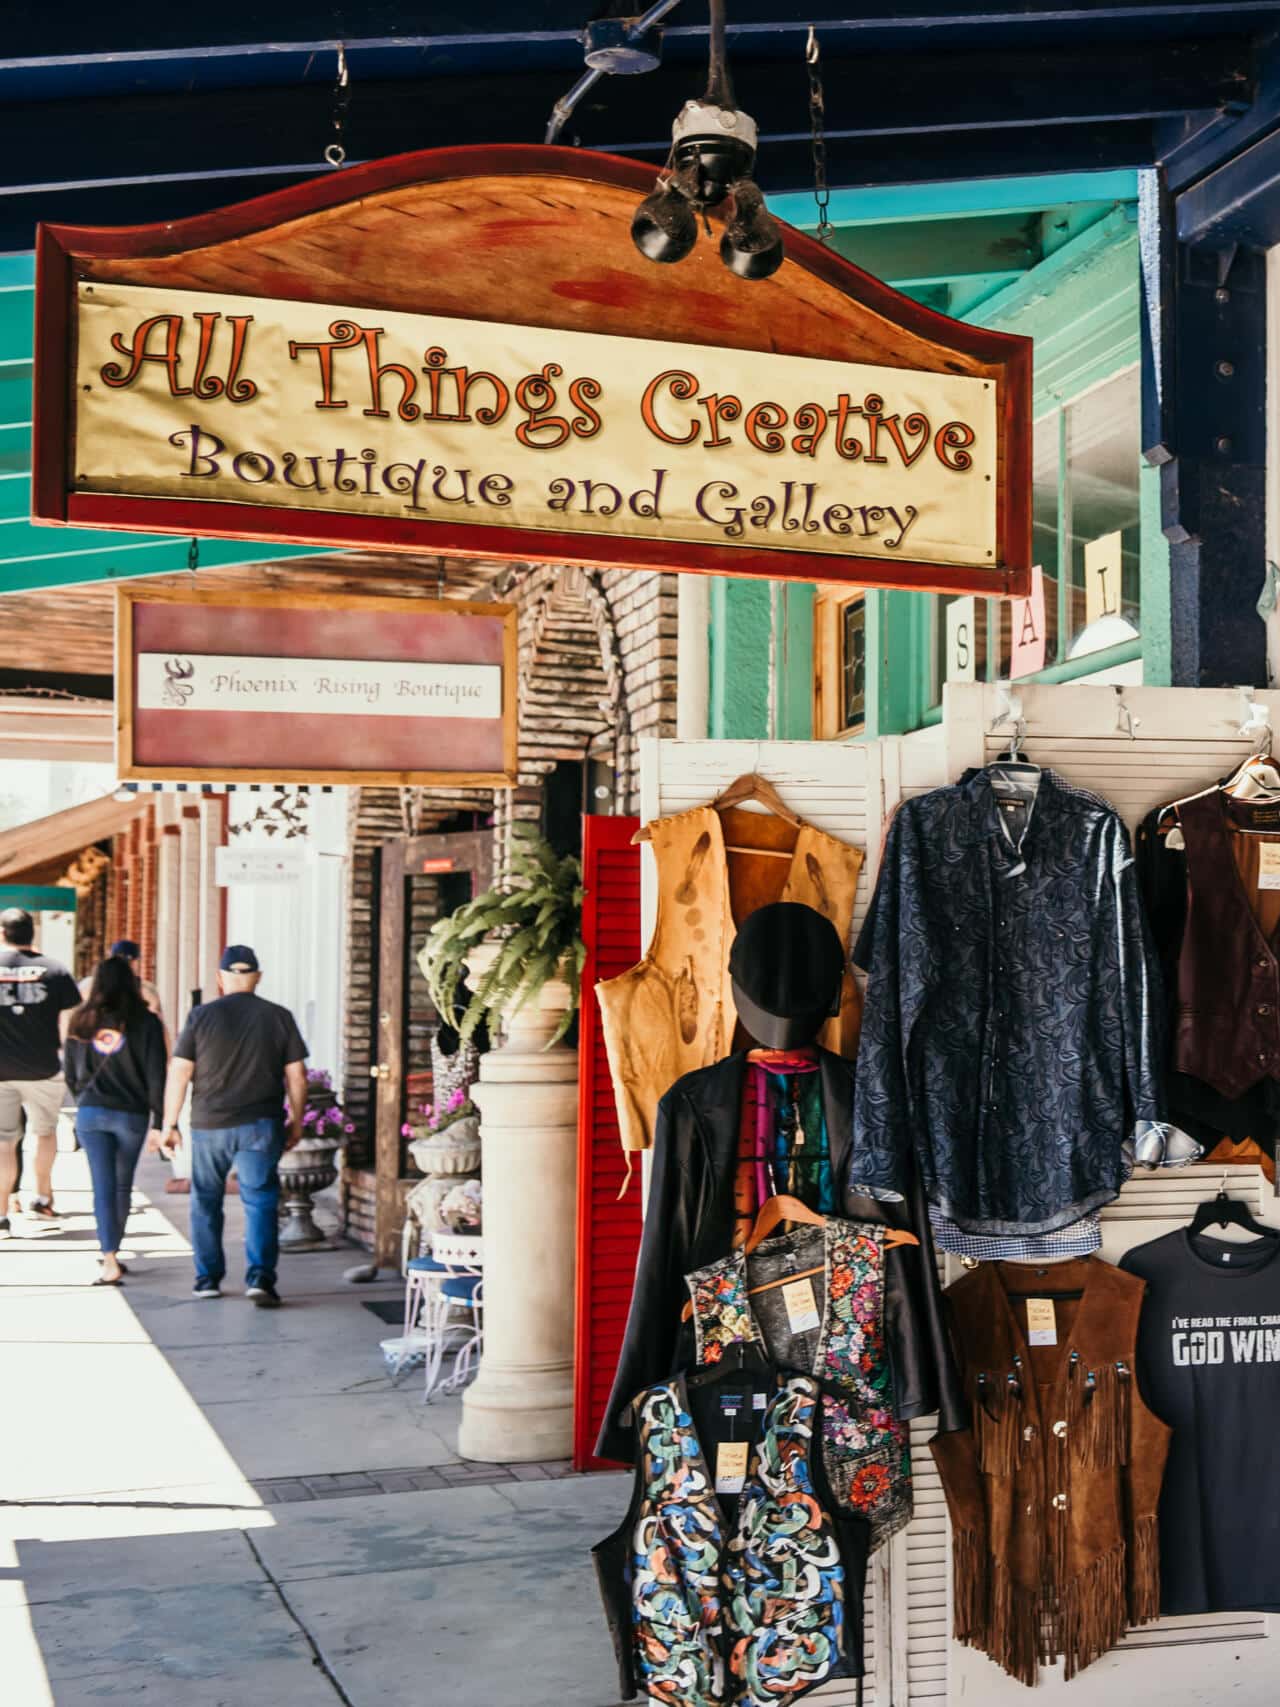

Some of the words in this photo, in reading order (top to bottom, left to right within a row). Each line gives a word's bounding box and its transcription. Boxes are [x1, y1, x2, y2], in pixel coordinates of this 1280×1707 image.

[101, 312, 257, 402] All
[289, 320, 603, 449] Things
[641, 369, 976, 471] Creative
[168, 424, 515, 512] Boutique
[547, 469, 668, 520] and
[696, 481, 918, 548] Gallery
[210, 671, 299, 694] Phoenix
[313, 676, 381, 703] Rising
[393, 678, 483, 703] Boutique
[1172, 1316, 1190, 1329] I'VE
[1190, 1317, 1214, 1328] READ
[1215, 1316, 1232, 1327] THE
[1233, 1316, 1258, 1326] FINAL
[1172, 1331, 1224, 1366] GOD
